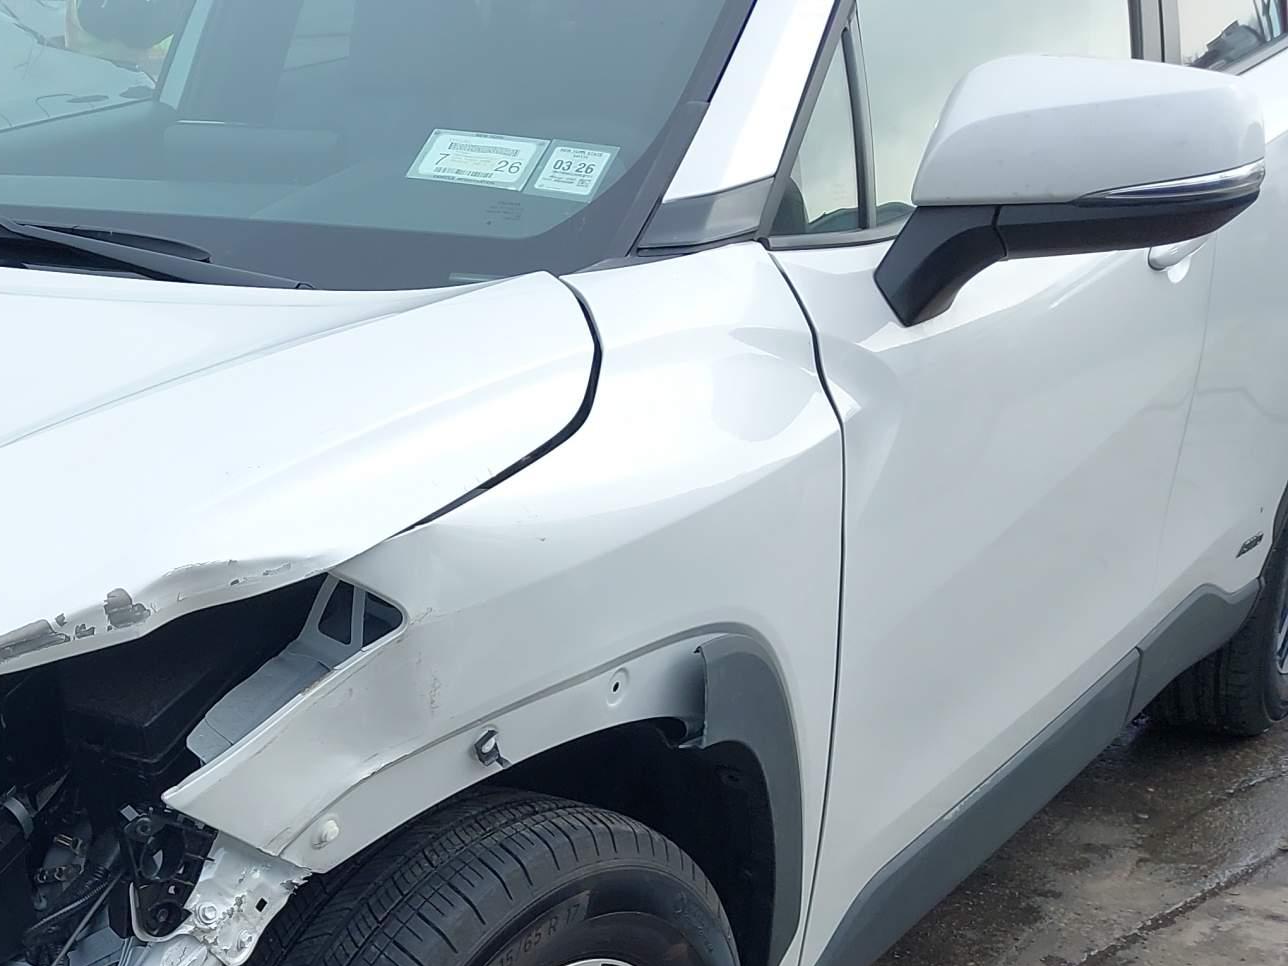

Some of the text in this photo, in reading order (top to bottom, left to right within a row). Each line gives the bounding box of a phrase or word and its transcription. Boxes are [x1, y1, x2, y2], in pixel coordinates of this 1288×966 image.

[494, 159, 522, 174] 26
[552, 159, 596, 174] 03 26
